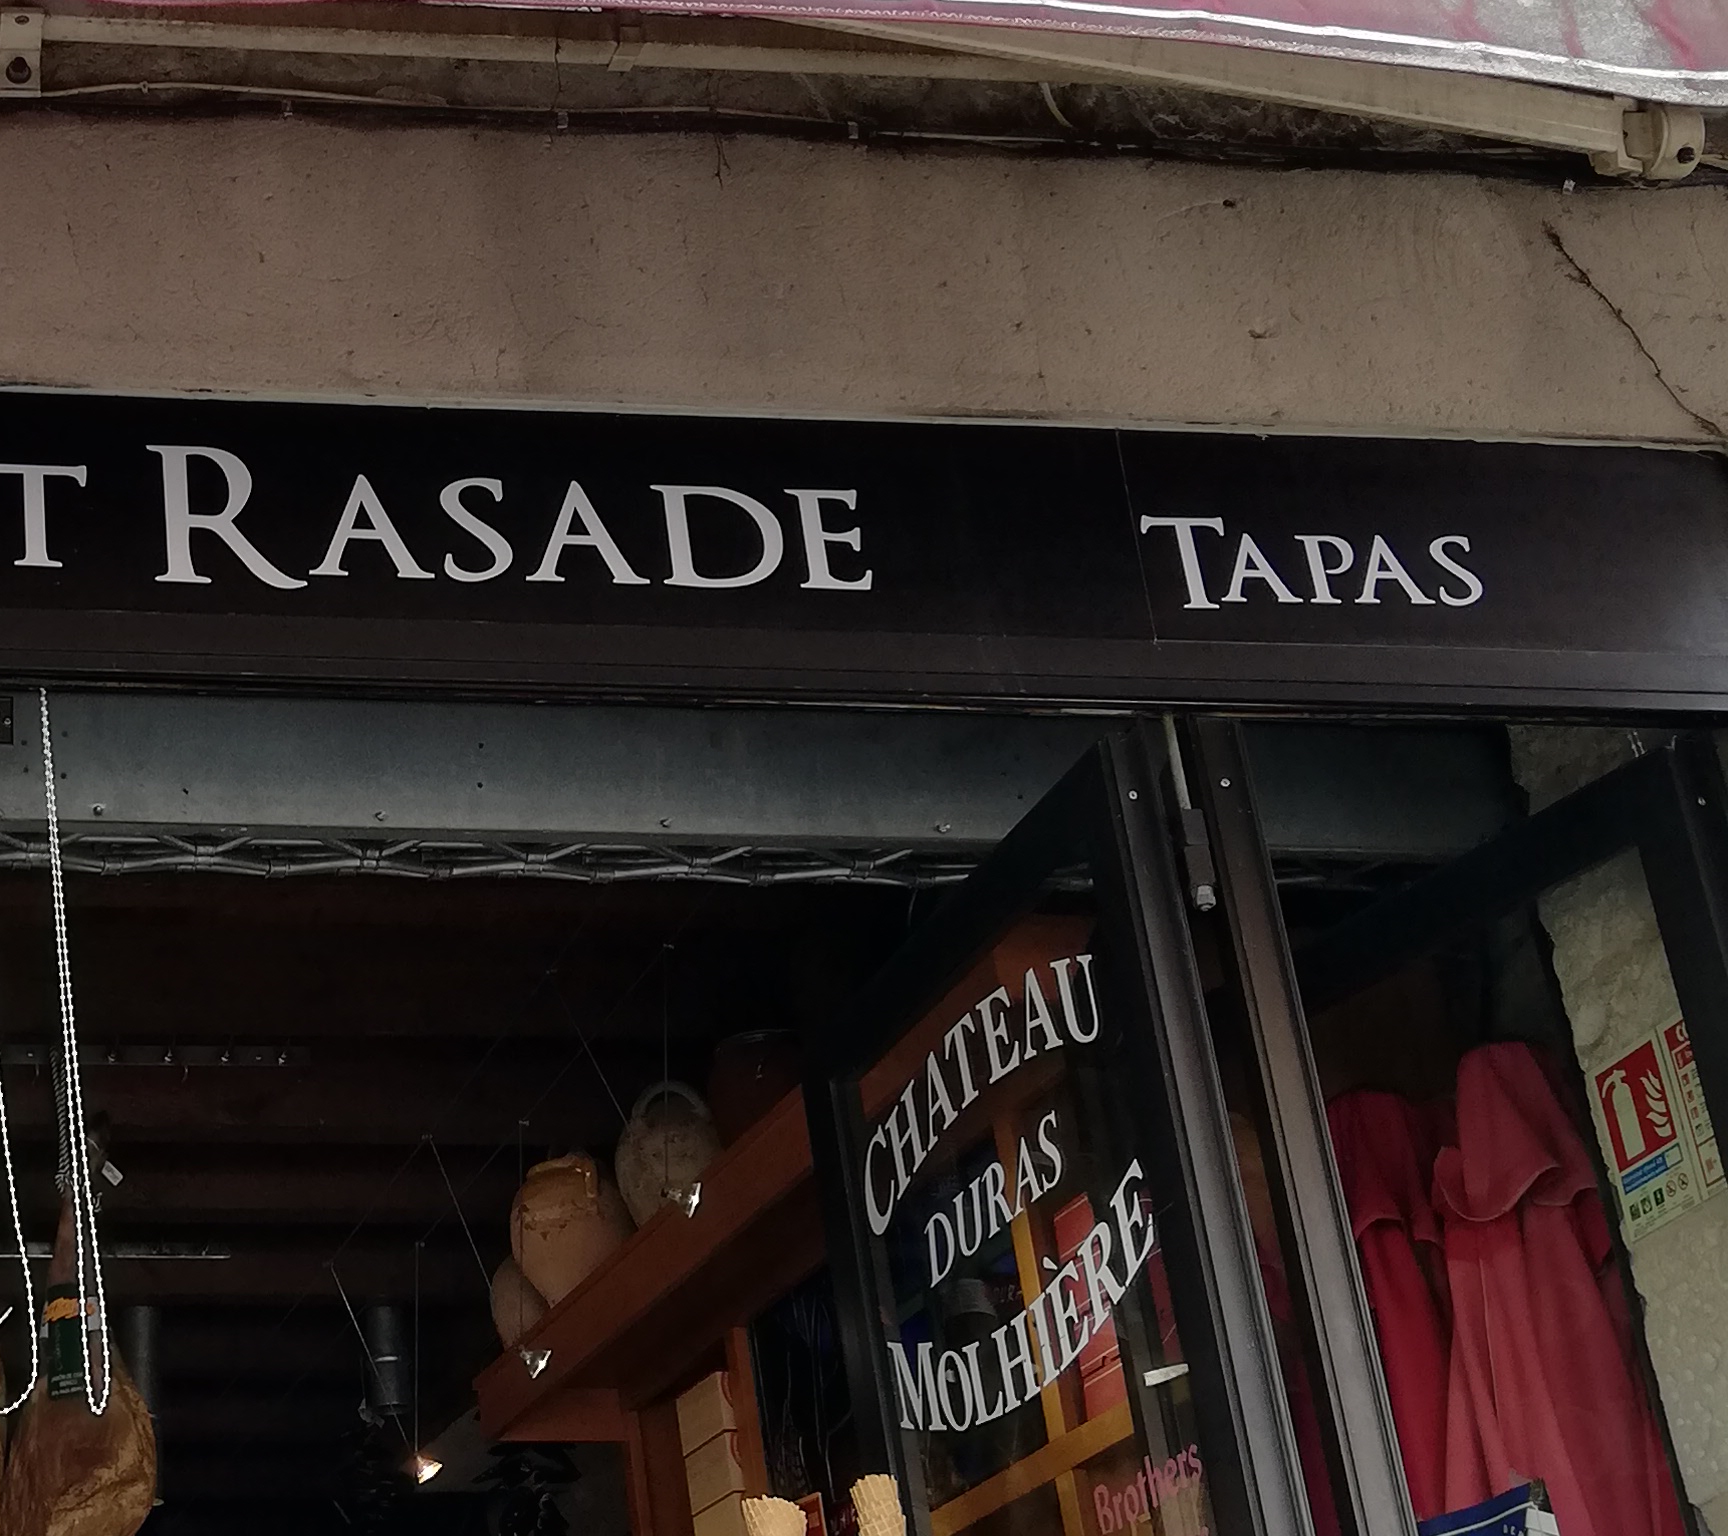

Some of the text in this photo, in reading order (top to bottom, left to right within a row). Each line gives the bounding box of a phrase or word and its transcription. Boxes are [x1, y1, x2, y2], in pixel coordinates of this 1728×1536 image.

[145, 444, 872, 591] RASADE
[1140, 515, 1484, 610] TAPAS
[864, 954, 1100, 1236] CHATEAU
[923, 1110, 1063, 1288] DURAS
[887, 1158, 1154, 1432] MOLHIÈRE
[1093, 1444, 1202, 1535] Brothers
